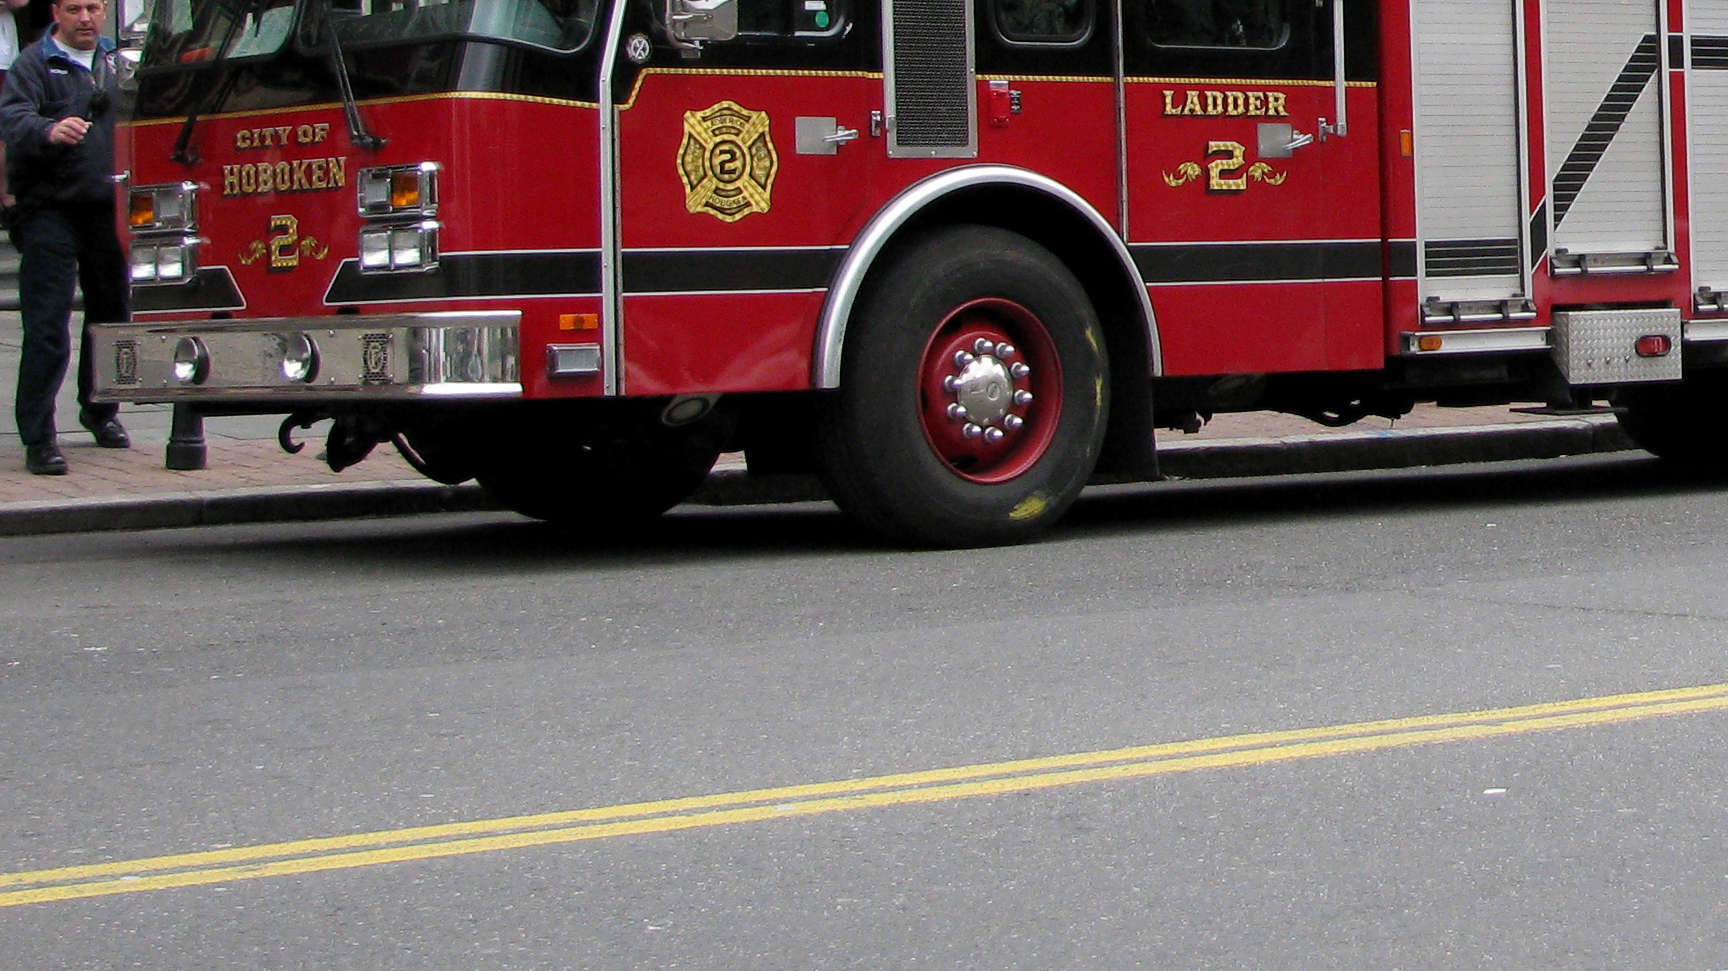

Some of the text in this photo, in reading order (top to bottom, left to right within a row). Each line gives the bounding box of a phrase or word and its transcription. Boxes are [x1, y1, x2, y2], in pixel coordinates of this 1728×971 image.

[1162, 90, 1290, 116] LADDER
[236, 123, 330, 148] CITY OF
[222, 156, 347, 195] HOBOKEN
[718, 148, 738, 175] 2
[1208, 140, 1247, 190] 2
[269, 214, 299, 267] 2
